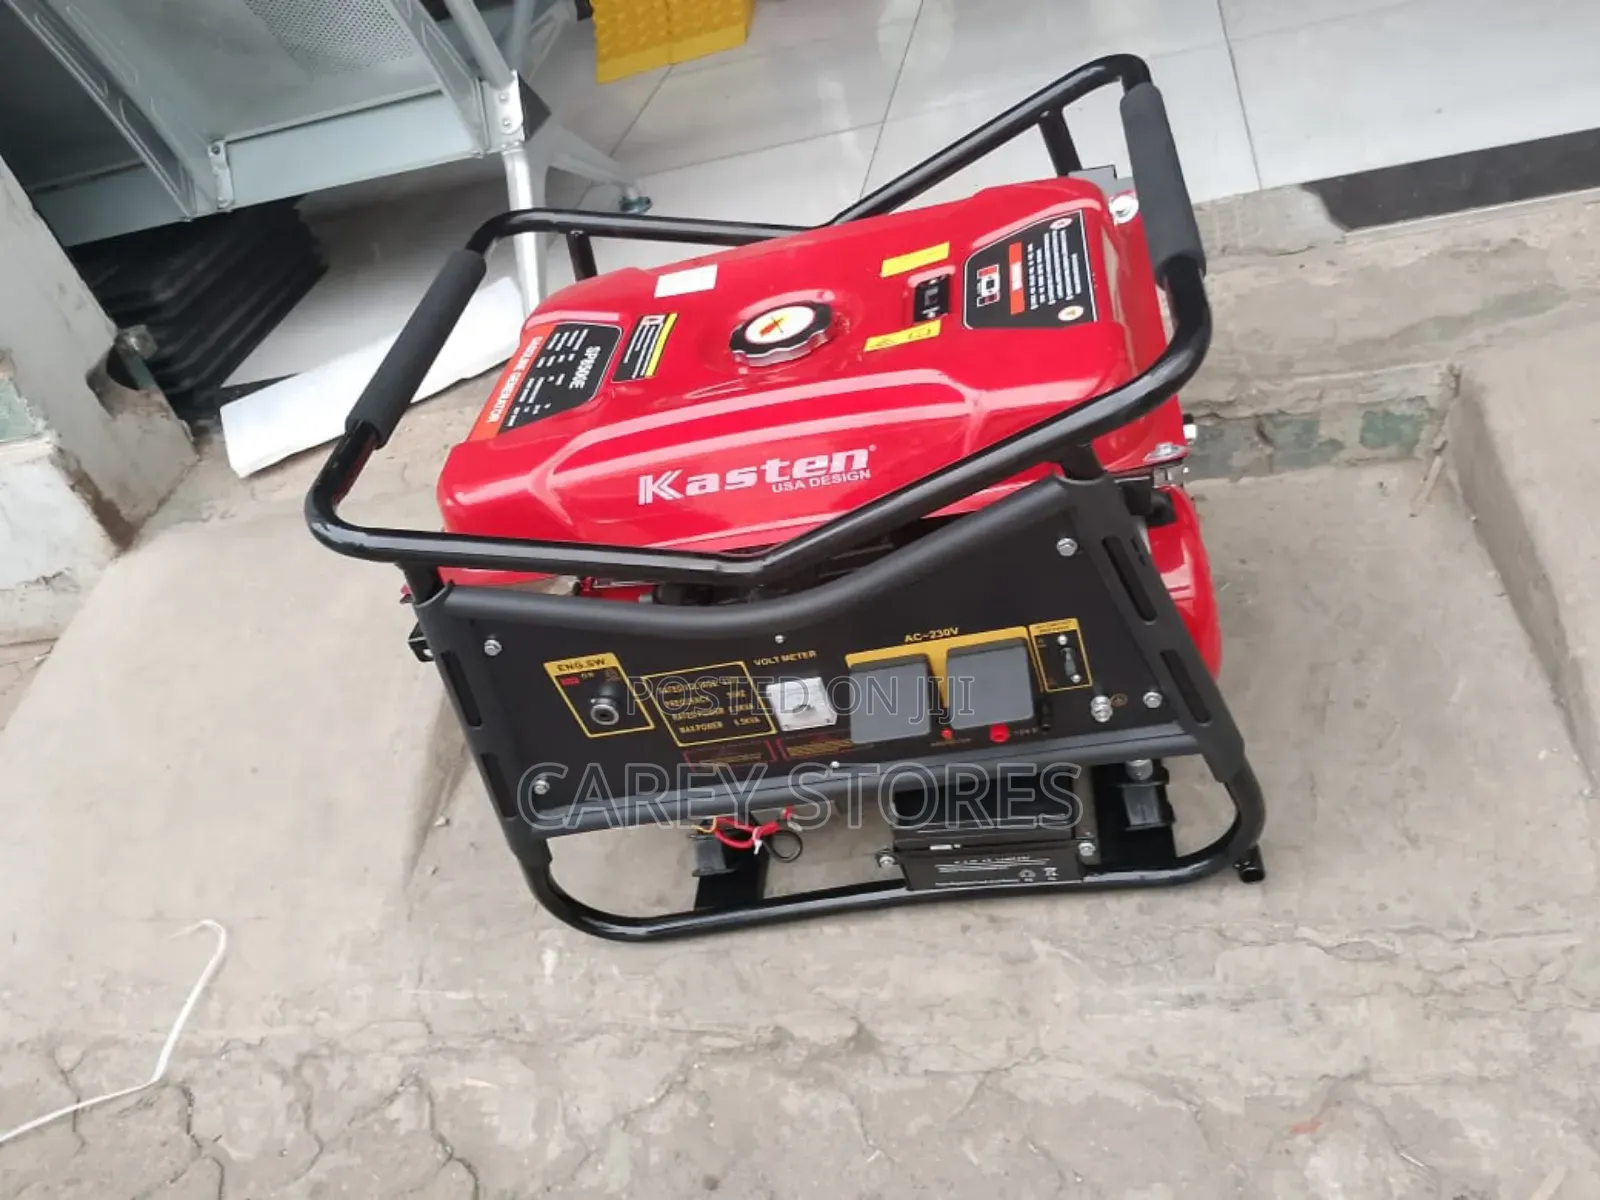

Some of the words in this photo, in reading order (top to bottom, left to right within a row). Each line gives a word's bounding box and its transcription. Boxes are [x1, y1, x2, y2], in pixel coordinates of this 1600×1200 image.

[637, 447, 869, 505] Kasten
[771, 479, 806, 494] USA
[809, 469, 871, 488] DESIGN
[780, 650, 817, 662] METER
